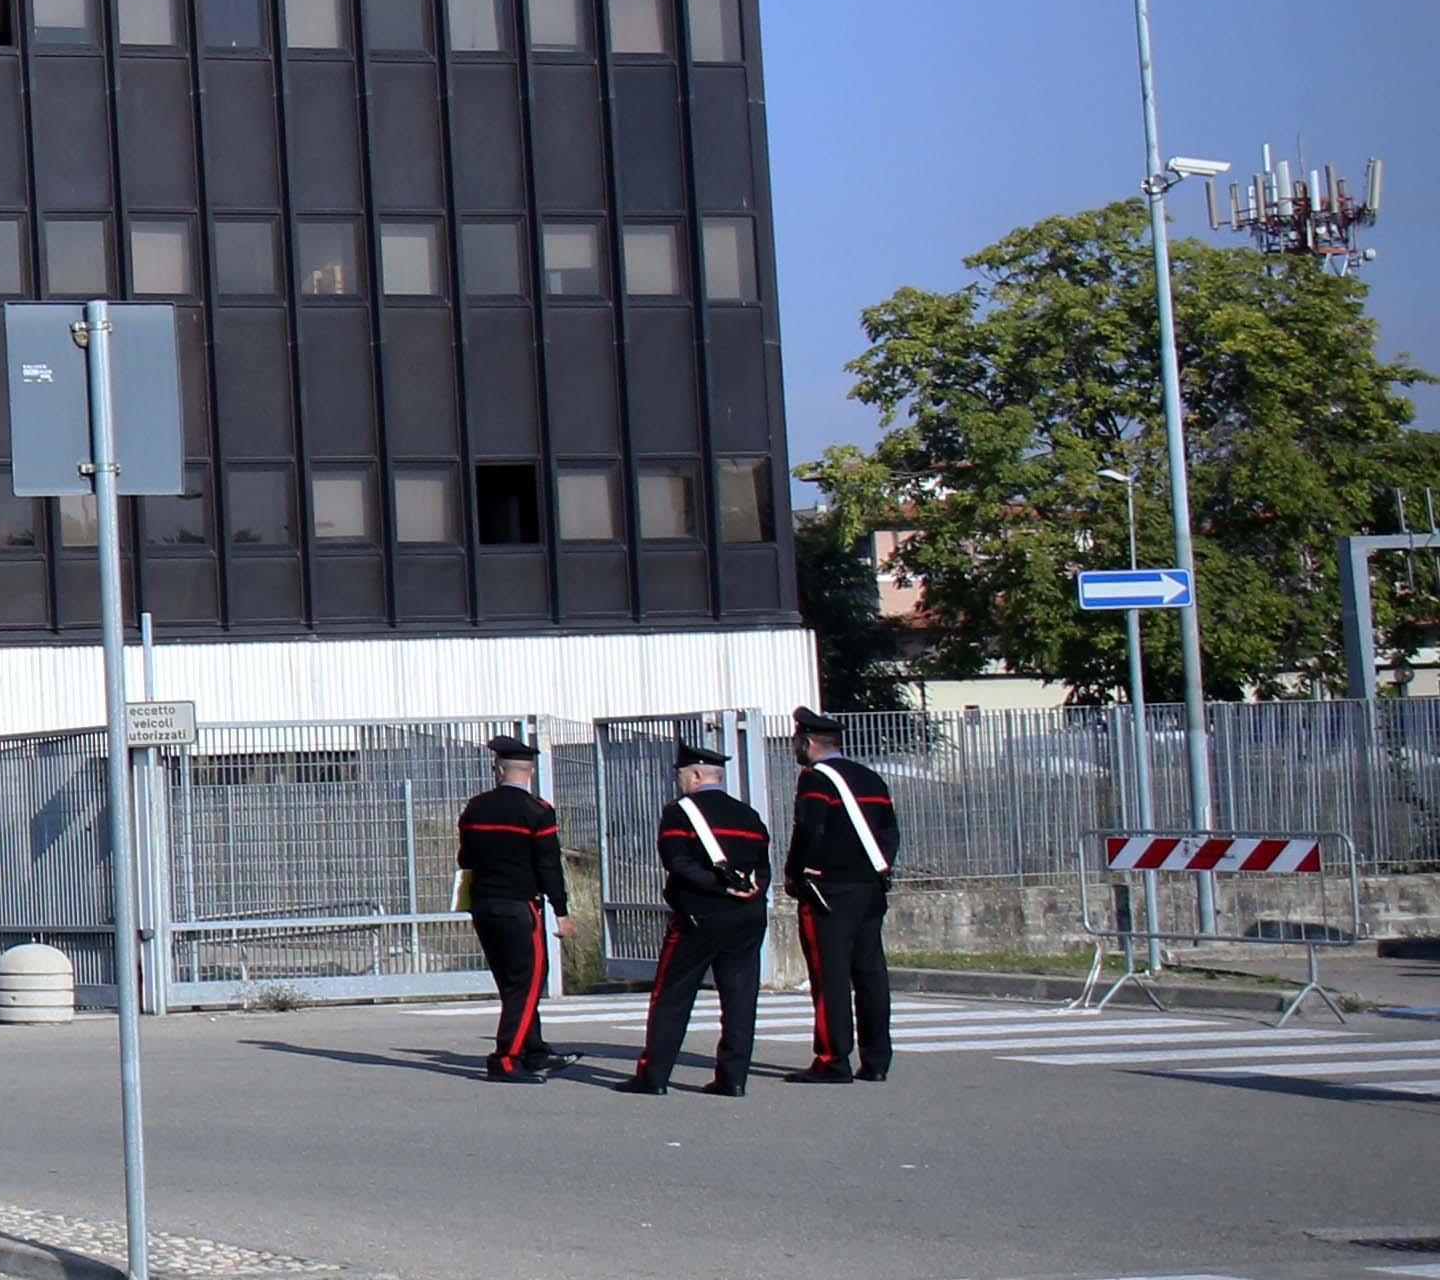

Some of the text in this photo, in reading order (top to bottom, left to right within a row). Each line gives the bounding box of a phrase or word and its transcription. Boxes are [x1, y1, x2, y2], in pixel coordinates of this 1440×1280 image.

[129, 705, 176, 716] eccetto
[133, 717, 174, 729] veicoli
[128, 728, 187, 741] utorizzati
